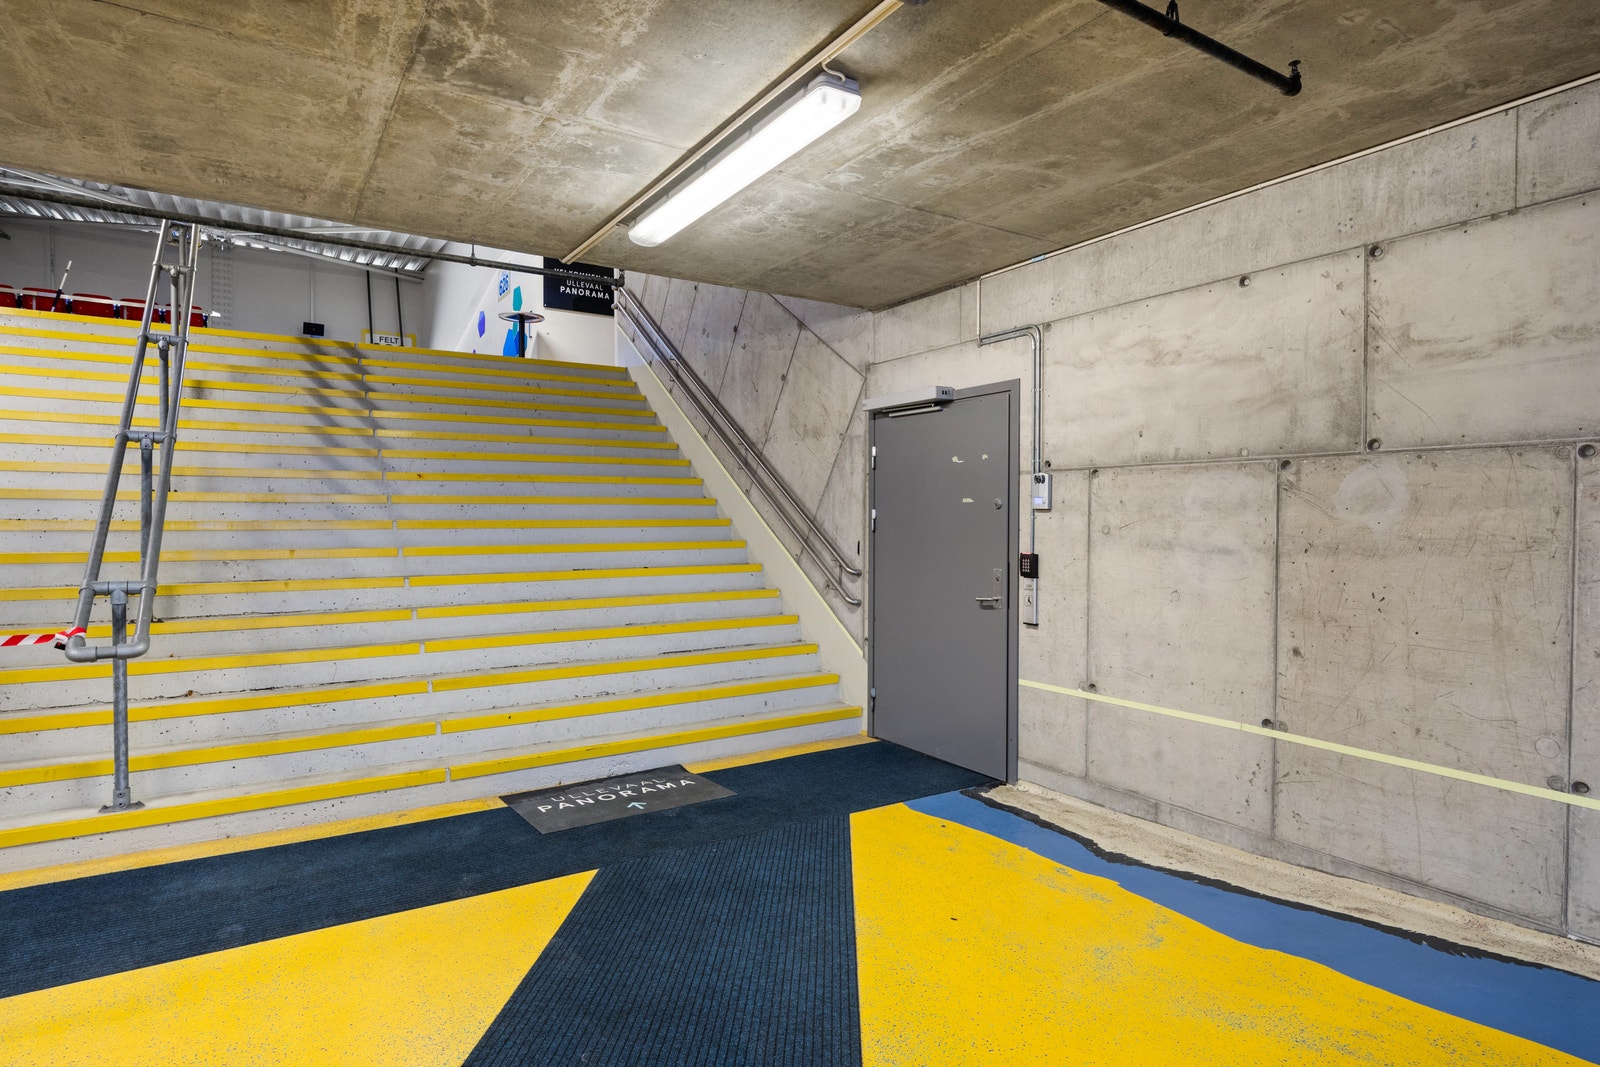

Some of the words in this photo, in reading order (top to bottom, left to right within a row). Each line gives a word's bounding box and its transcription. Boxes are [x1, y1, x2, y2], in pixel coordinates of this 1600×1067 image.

[566, 279, 604, 291] ULLEVAAL
[560, 286, 610, 300] PANORAMA
[379, 335, 399, 344] FELT
[537, 779, 696, 813] PANORAMA
[551, 778, 666, 802] ULLEVAAL
